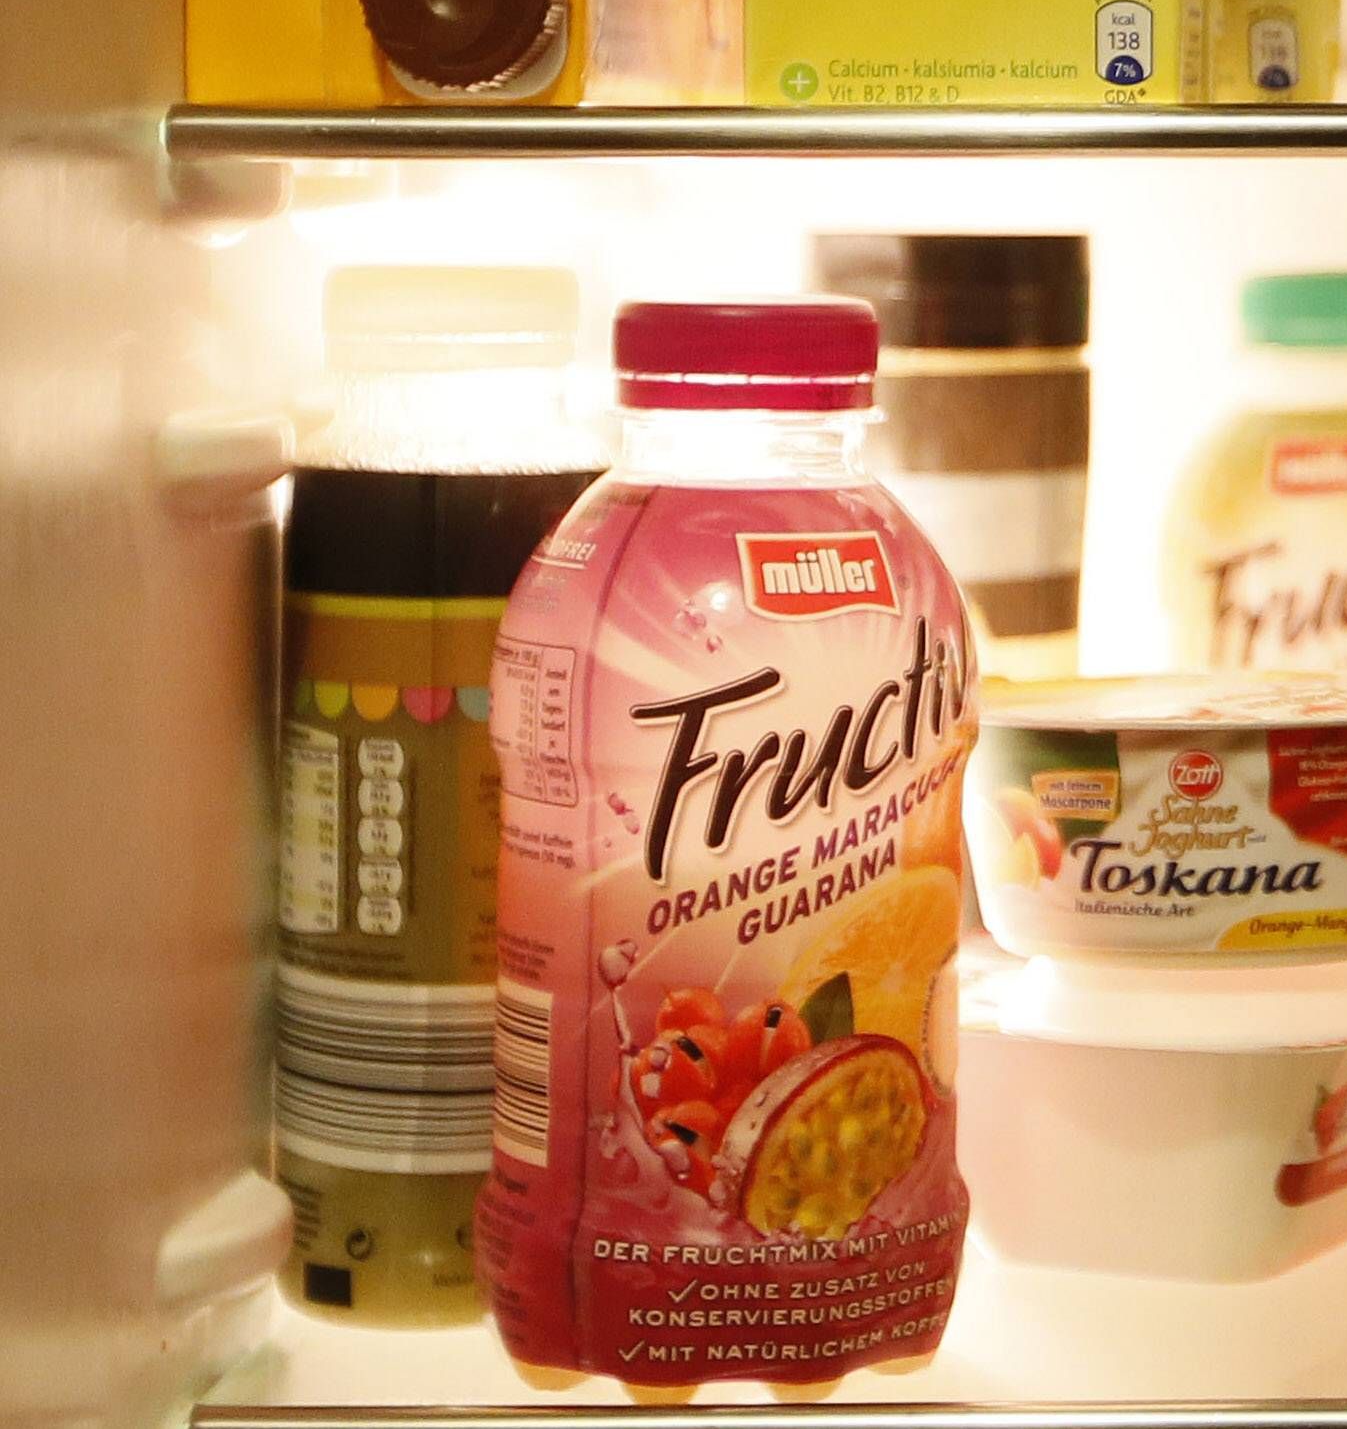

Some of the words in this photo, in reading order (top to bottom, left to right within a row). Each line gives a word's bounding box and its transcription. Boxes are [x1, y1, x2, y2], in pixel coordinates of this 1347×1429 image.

[1111, 13, 1136, 27] kcal
[1107, 31, 1140, 51] 138
[828, 59, 899, 79] Calcium
[912, 59, 996, 79] kalsiumia
[1009, 59, 1078, 79] kalcium
[1113, 63, 1137, 78] 7%
[828, 85, 857, 102] Vit.
[862, 85, 891, 104] B2,
[895, 85, 924, 102] B12
[945, 86, 960, 102] D
[761, 549, 879, 597] müller
[1069, 838, 1326, 899] Toskana
[645, 846, 802, 938] ORANGE
[737, 838, 899, 946] GUARANA
[1073, 898, 1164, 917] Italienische
[594, 1238, 650, 1265] DER
[662, 1240, 839, 1266] FRUCHTMIX
[848, 1231, 889, 1259] MIT
[699, 1280, 780, 1301] OHNE
[790, 1272, 881, 1300] ZUSATZ
[884, 1259, 927, 1283] VON
[649, 1343, 694, 1363] MIT
[707, 1326, 884, 1362] NATÜRLICHEM
